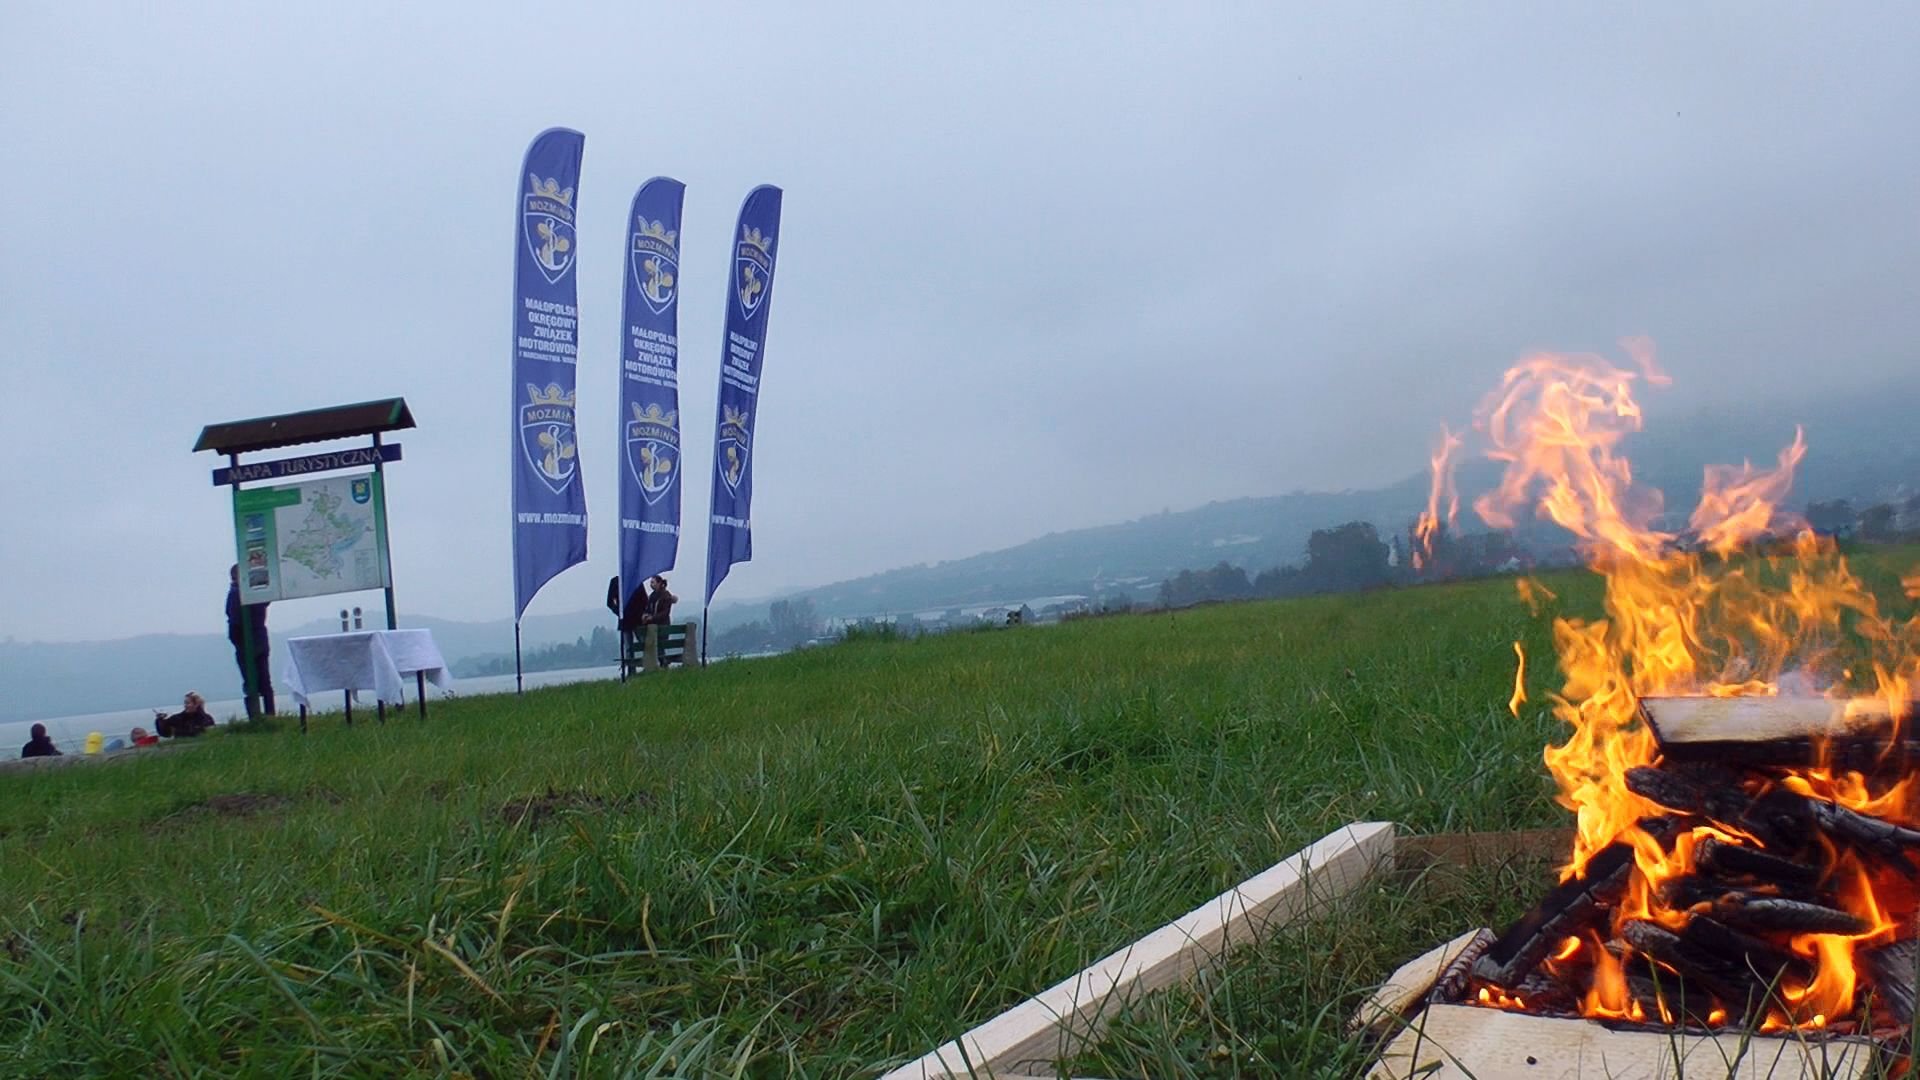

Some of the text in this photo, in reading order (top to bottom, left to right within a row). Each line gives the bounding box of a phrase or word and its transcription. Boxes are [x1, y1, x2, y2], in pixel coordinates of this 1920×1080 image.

[534, 325, 572, 342] ZWIĄZEK
[228, 448, 383, 482] MAPA TURYSTYCZNA
